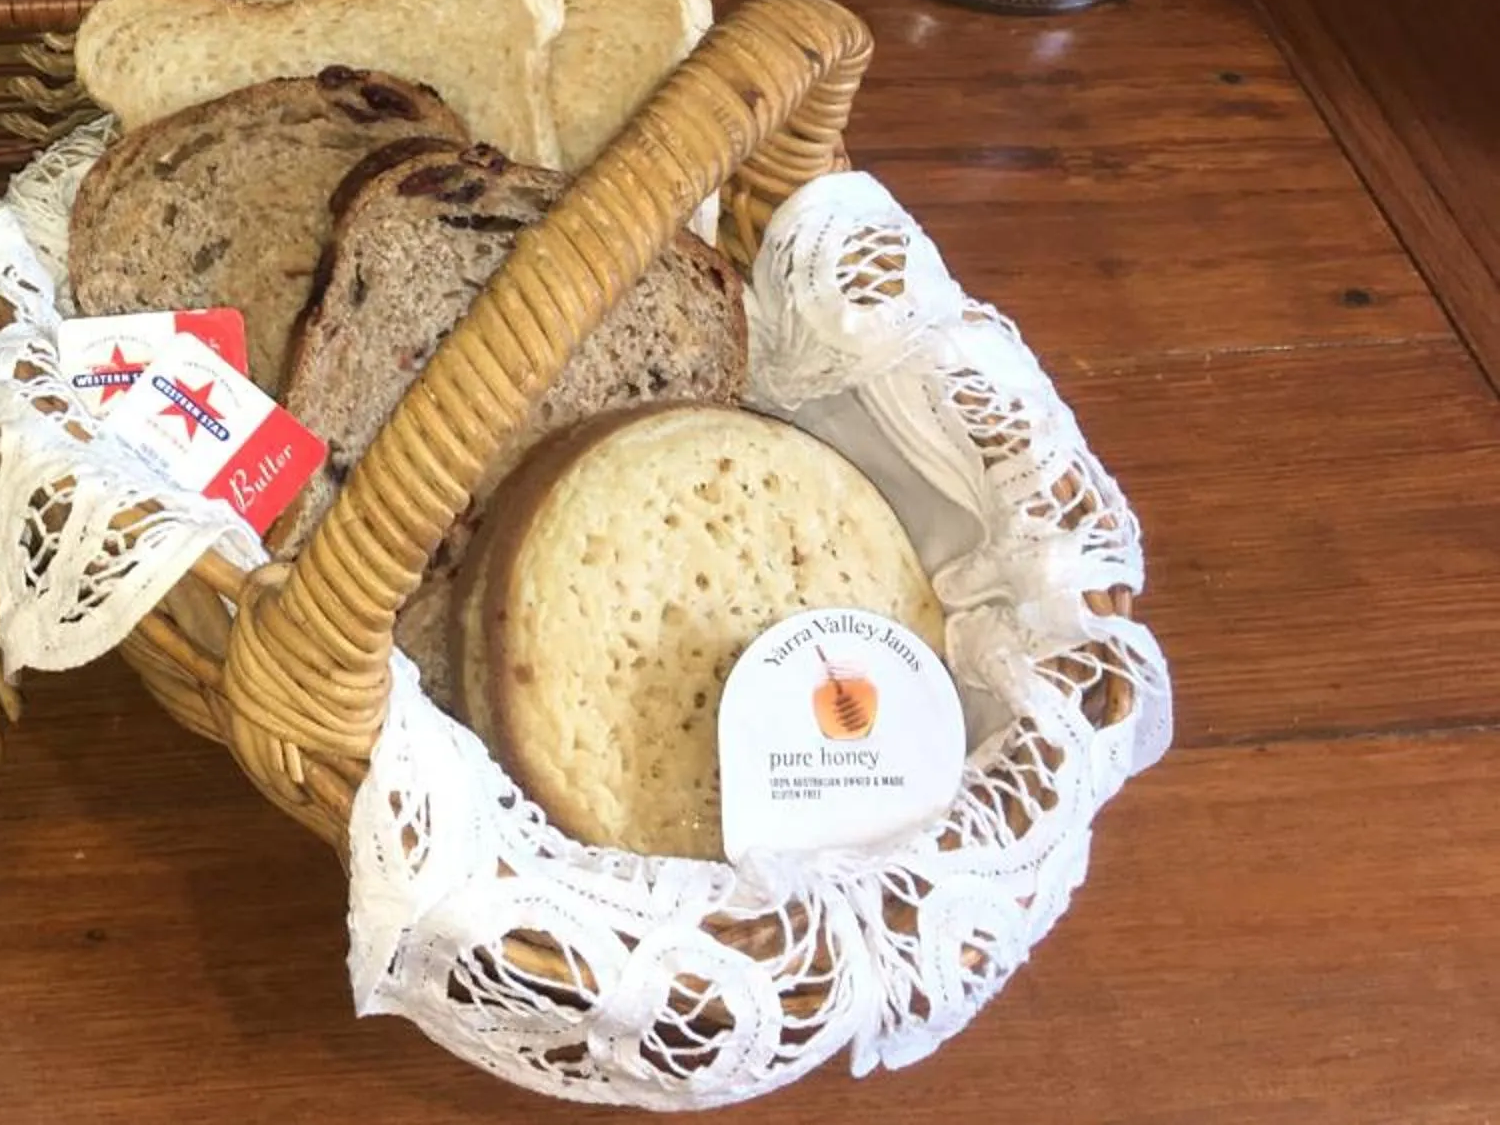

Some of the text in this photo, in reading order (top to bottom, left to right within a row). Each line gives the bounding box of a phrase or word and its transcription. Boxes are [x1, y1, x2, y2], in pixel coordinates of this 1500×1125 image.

[76, 374, 130, 388] WESTERN
[154, 378, 202, 419] WESTERN
[199, 413, 229, 441] STAR
[229, 443, 293, 513] Butter
[764, 614, 922, 673] Yarra Valley Jams
[769, 746, 880, 772] pure honey
